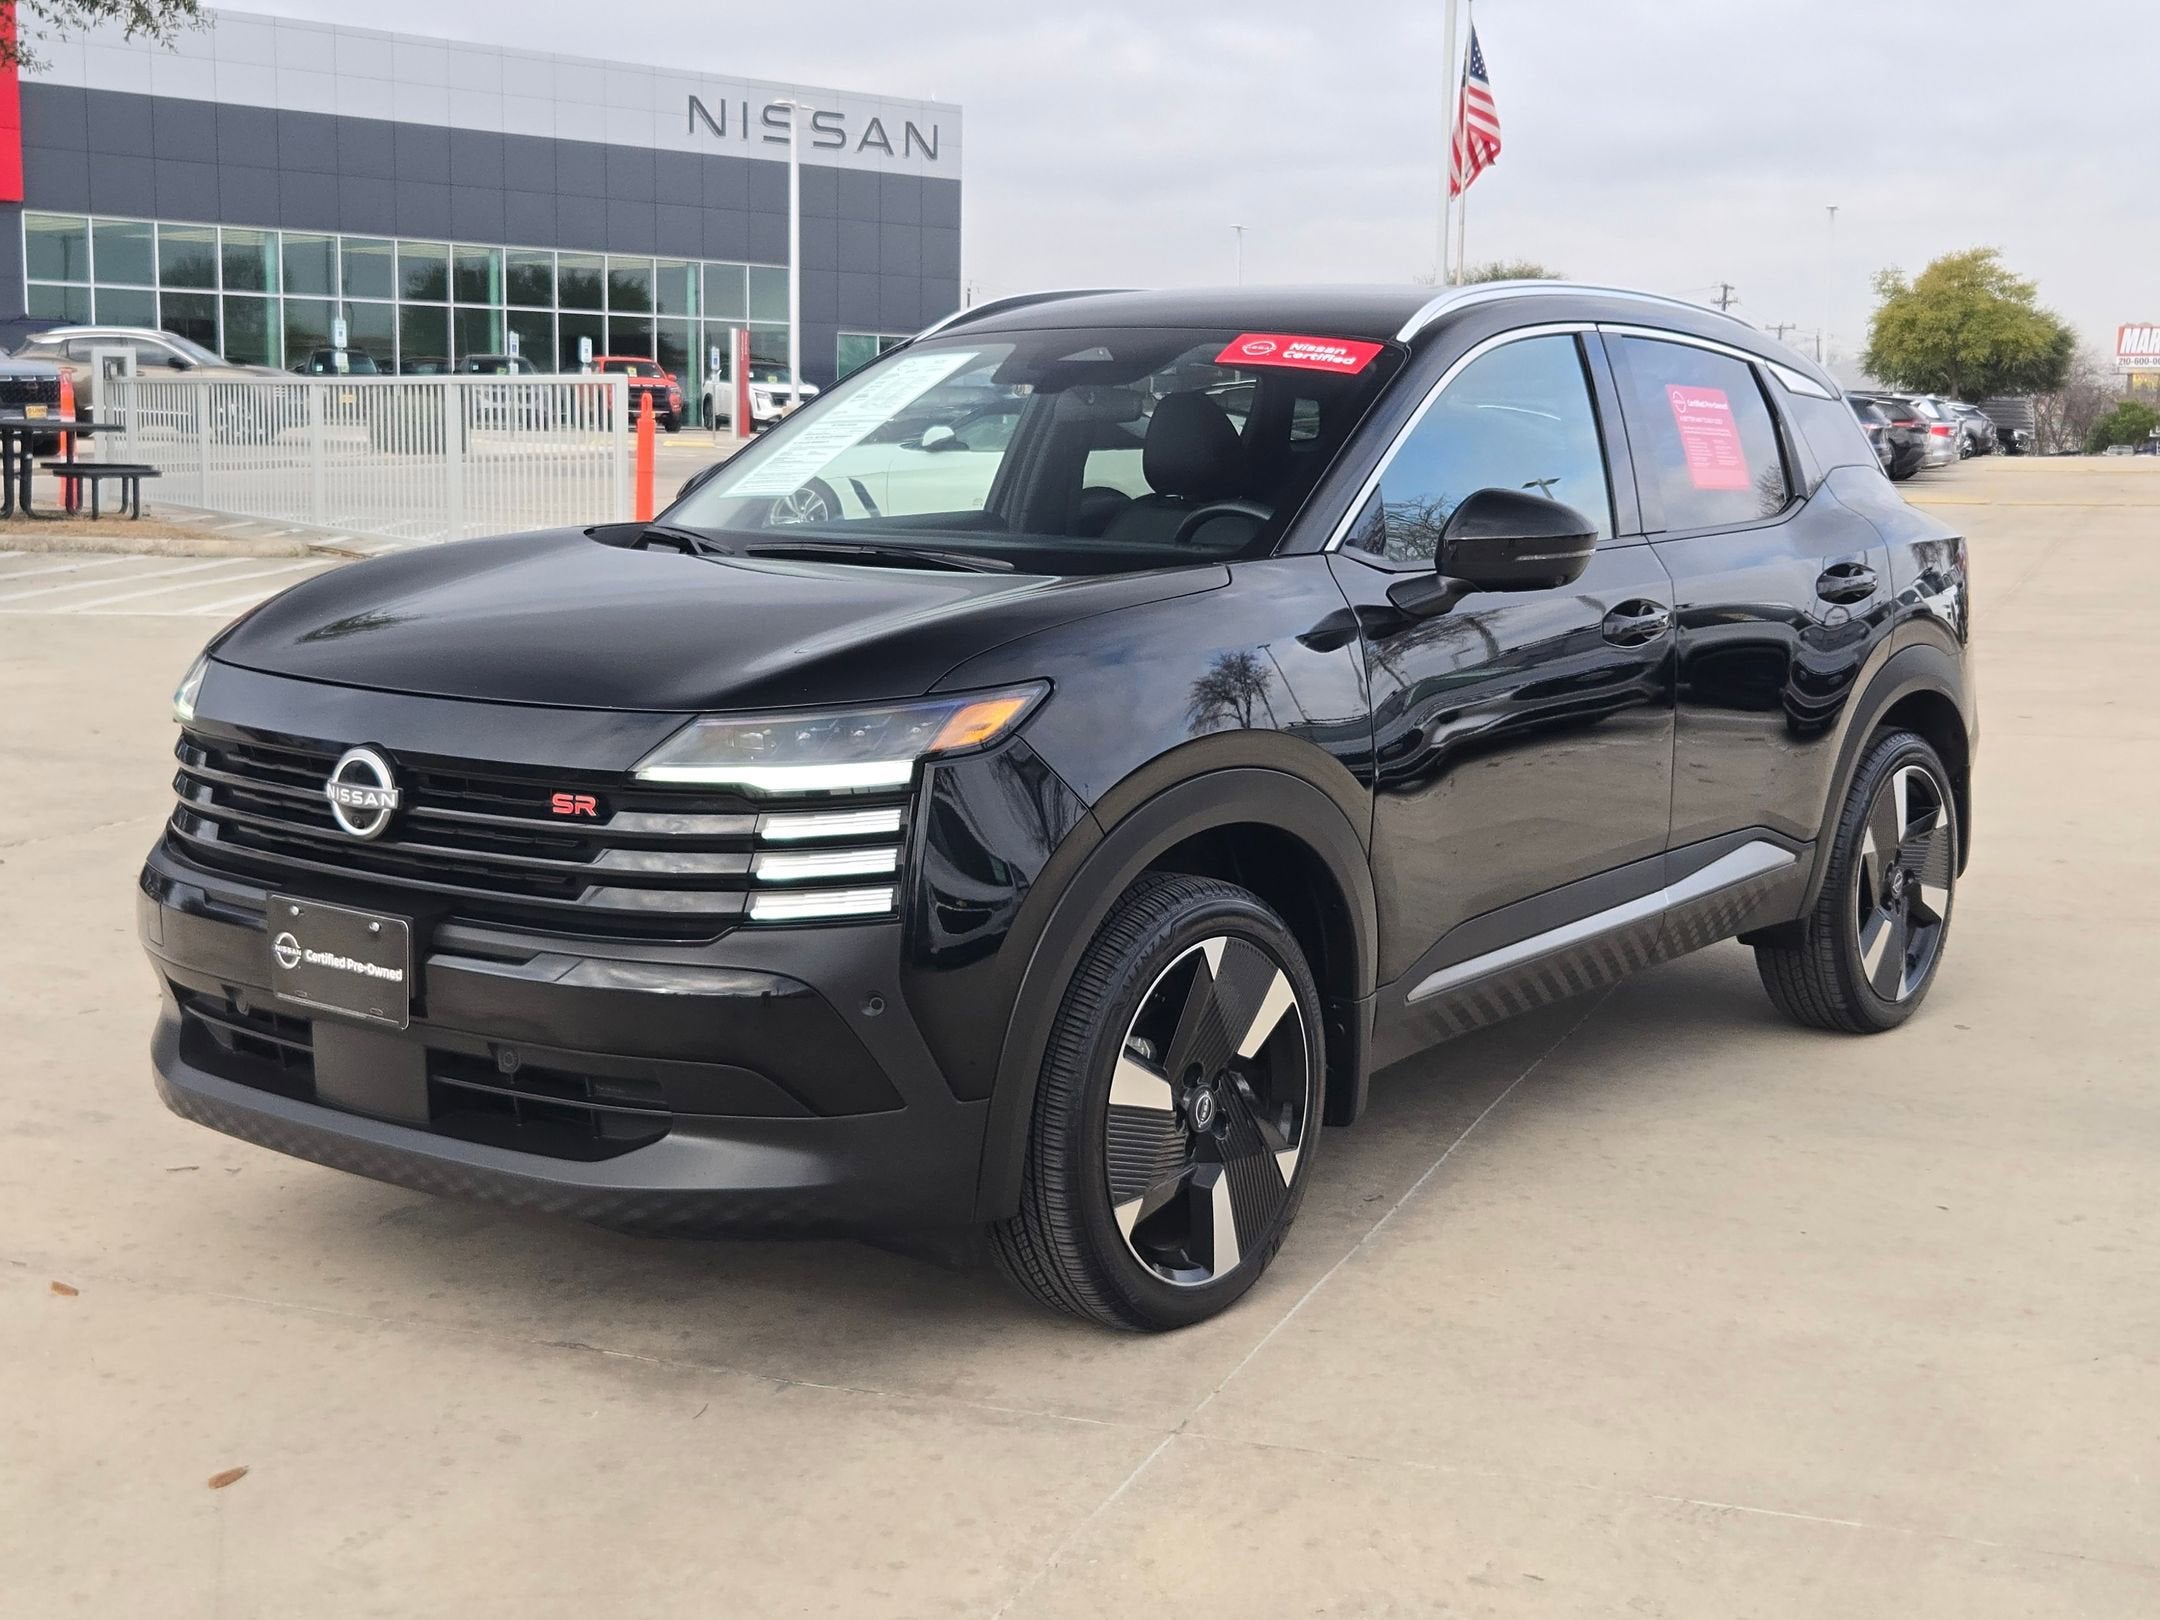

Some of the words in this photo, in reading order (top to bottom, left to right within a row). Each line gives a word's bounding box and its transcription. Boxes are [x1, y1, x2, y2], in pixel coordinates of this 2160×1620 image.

[688, 94, 938, 160] NISSAN
[1282, 350, 1356, 366] Certified
[1289, 341, 1348, 356] Nissan
[326, 782, 396, 808] NISSAN
[552, 793, 597, 817] SR
[274, 944, 302, 956] NISSAN
[305, 949, 346, 969] Certified
[346, 958, 403, 982] Pre-Owned
